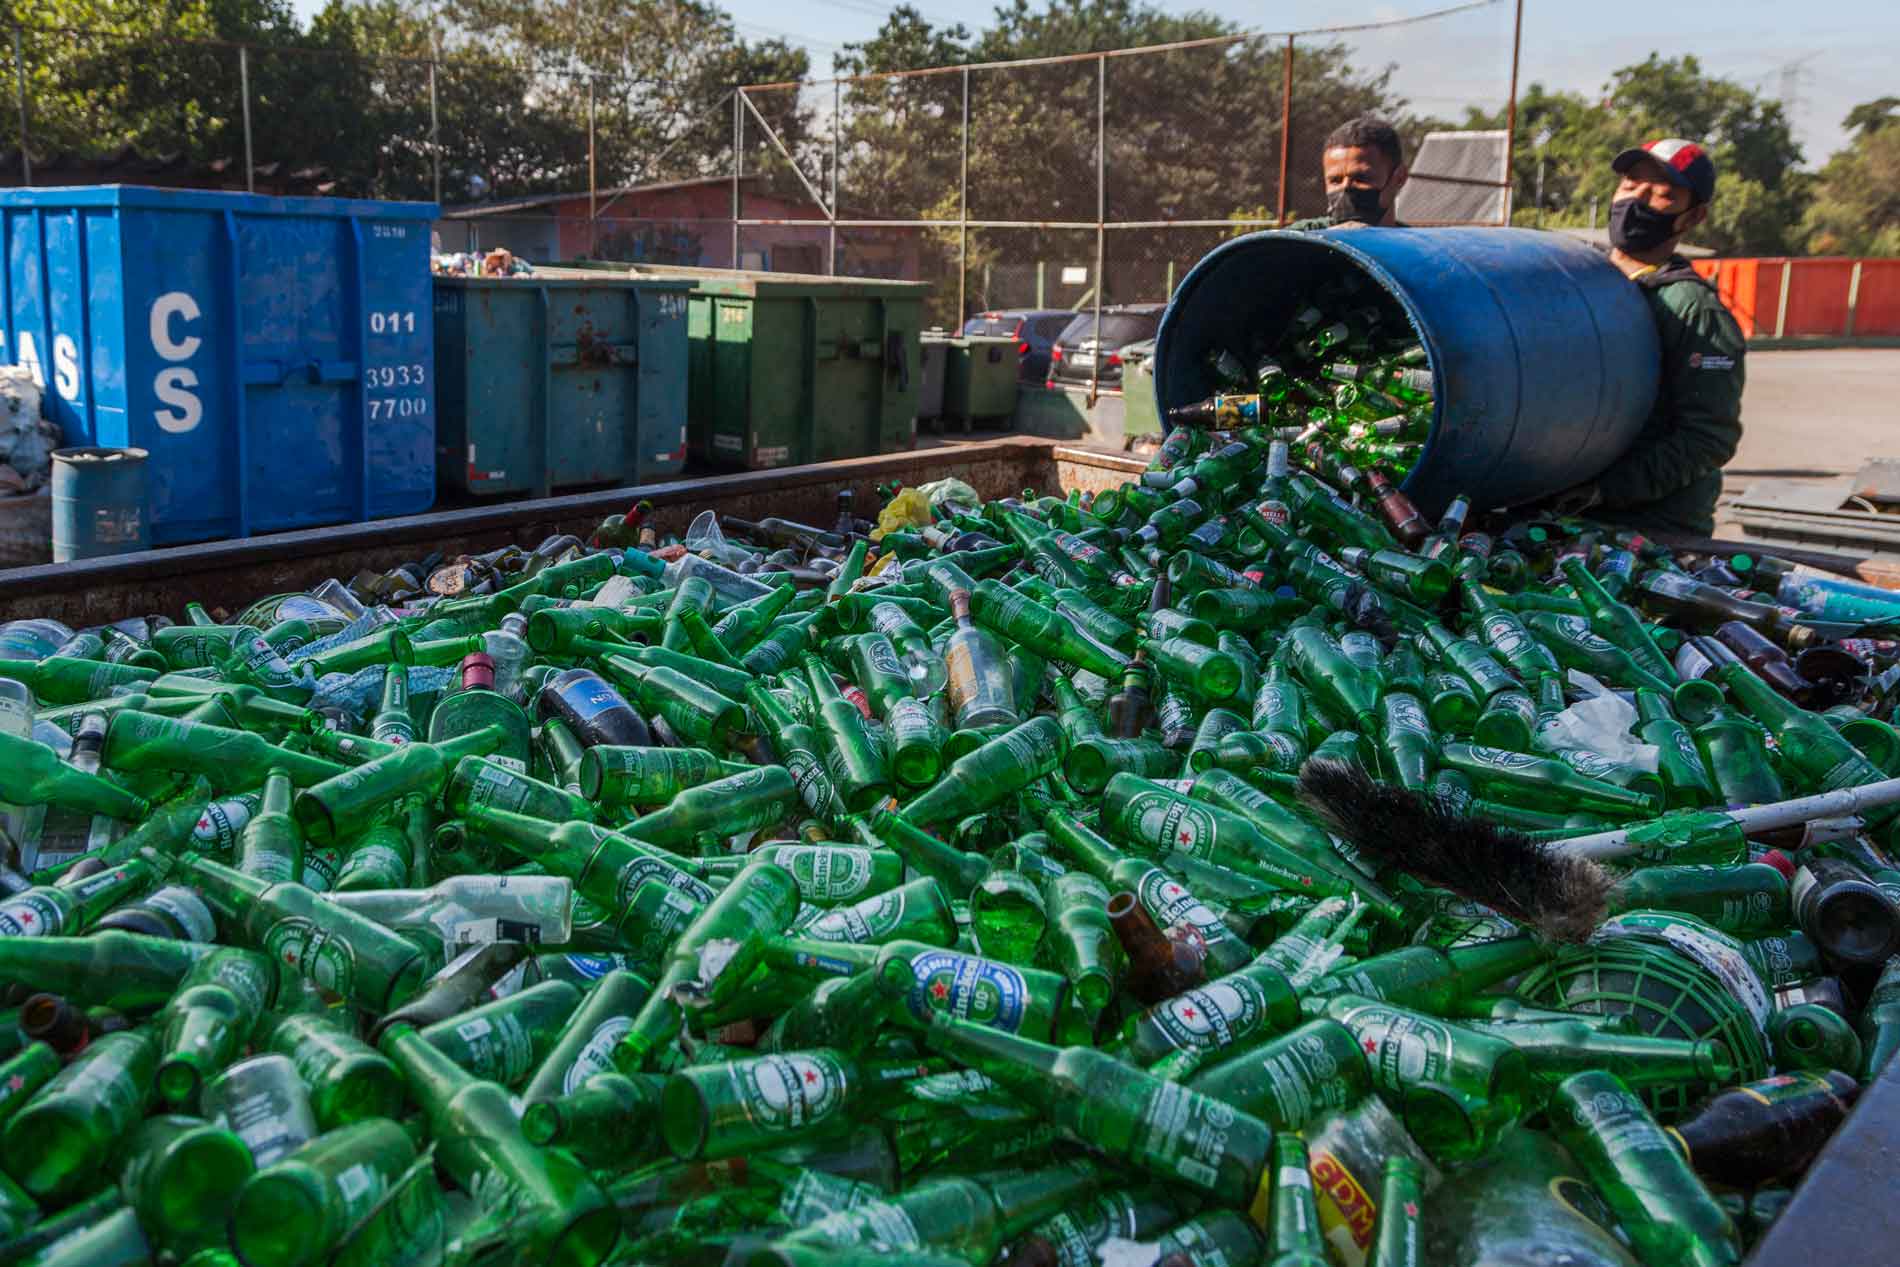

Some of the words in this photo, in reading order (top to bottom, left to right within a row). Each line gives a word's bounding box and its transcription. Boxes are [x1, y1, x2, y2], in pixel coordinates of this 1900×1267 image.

[370, 312, 416, 335] 011
[0, 329, 80, 401] AS
[366, 365, 426, 389] 3933
[368, 397, 427, 421] 7700
[1258, 859, 1300, 881] Heineken
